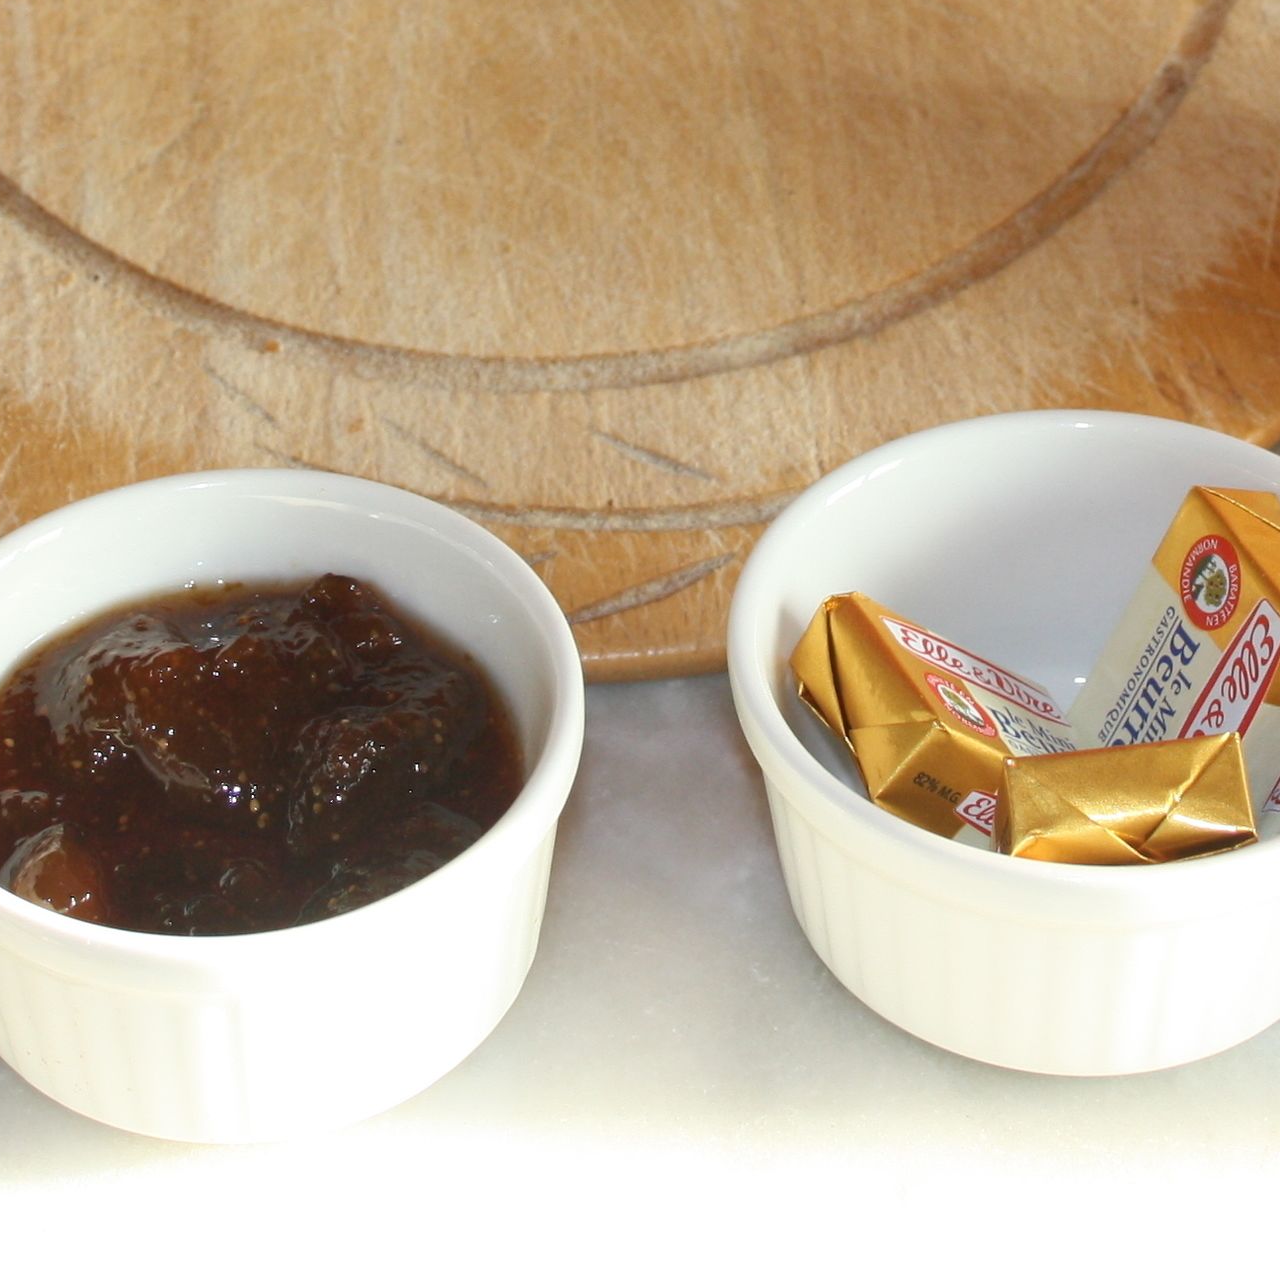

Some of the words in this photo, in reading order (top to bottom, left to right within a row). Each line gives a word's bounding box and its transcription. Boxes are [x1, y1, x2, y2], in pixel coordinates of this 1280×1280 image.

[1182, 538, 1218, 602] NORMANDIE
[900, 628, 970, 675] Elle
[987, 667, 1061, 719] Vire
[1098, 606, 1176, 743] GASTRONOMIQUE
[1171, 672, 1192, 695] le
[1221, 614, 1274, 703] Elle
[1201, 699, 1224, 728] &
